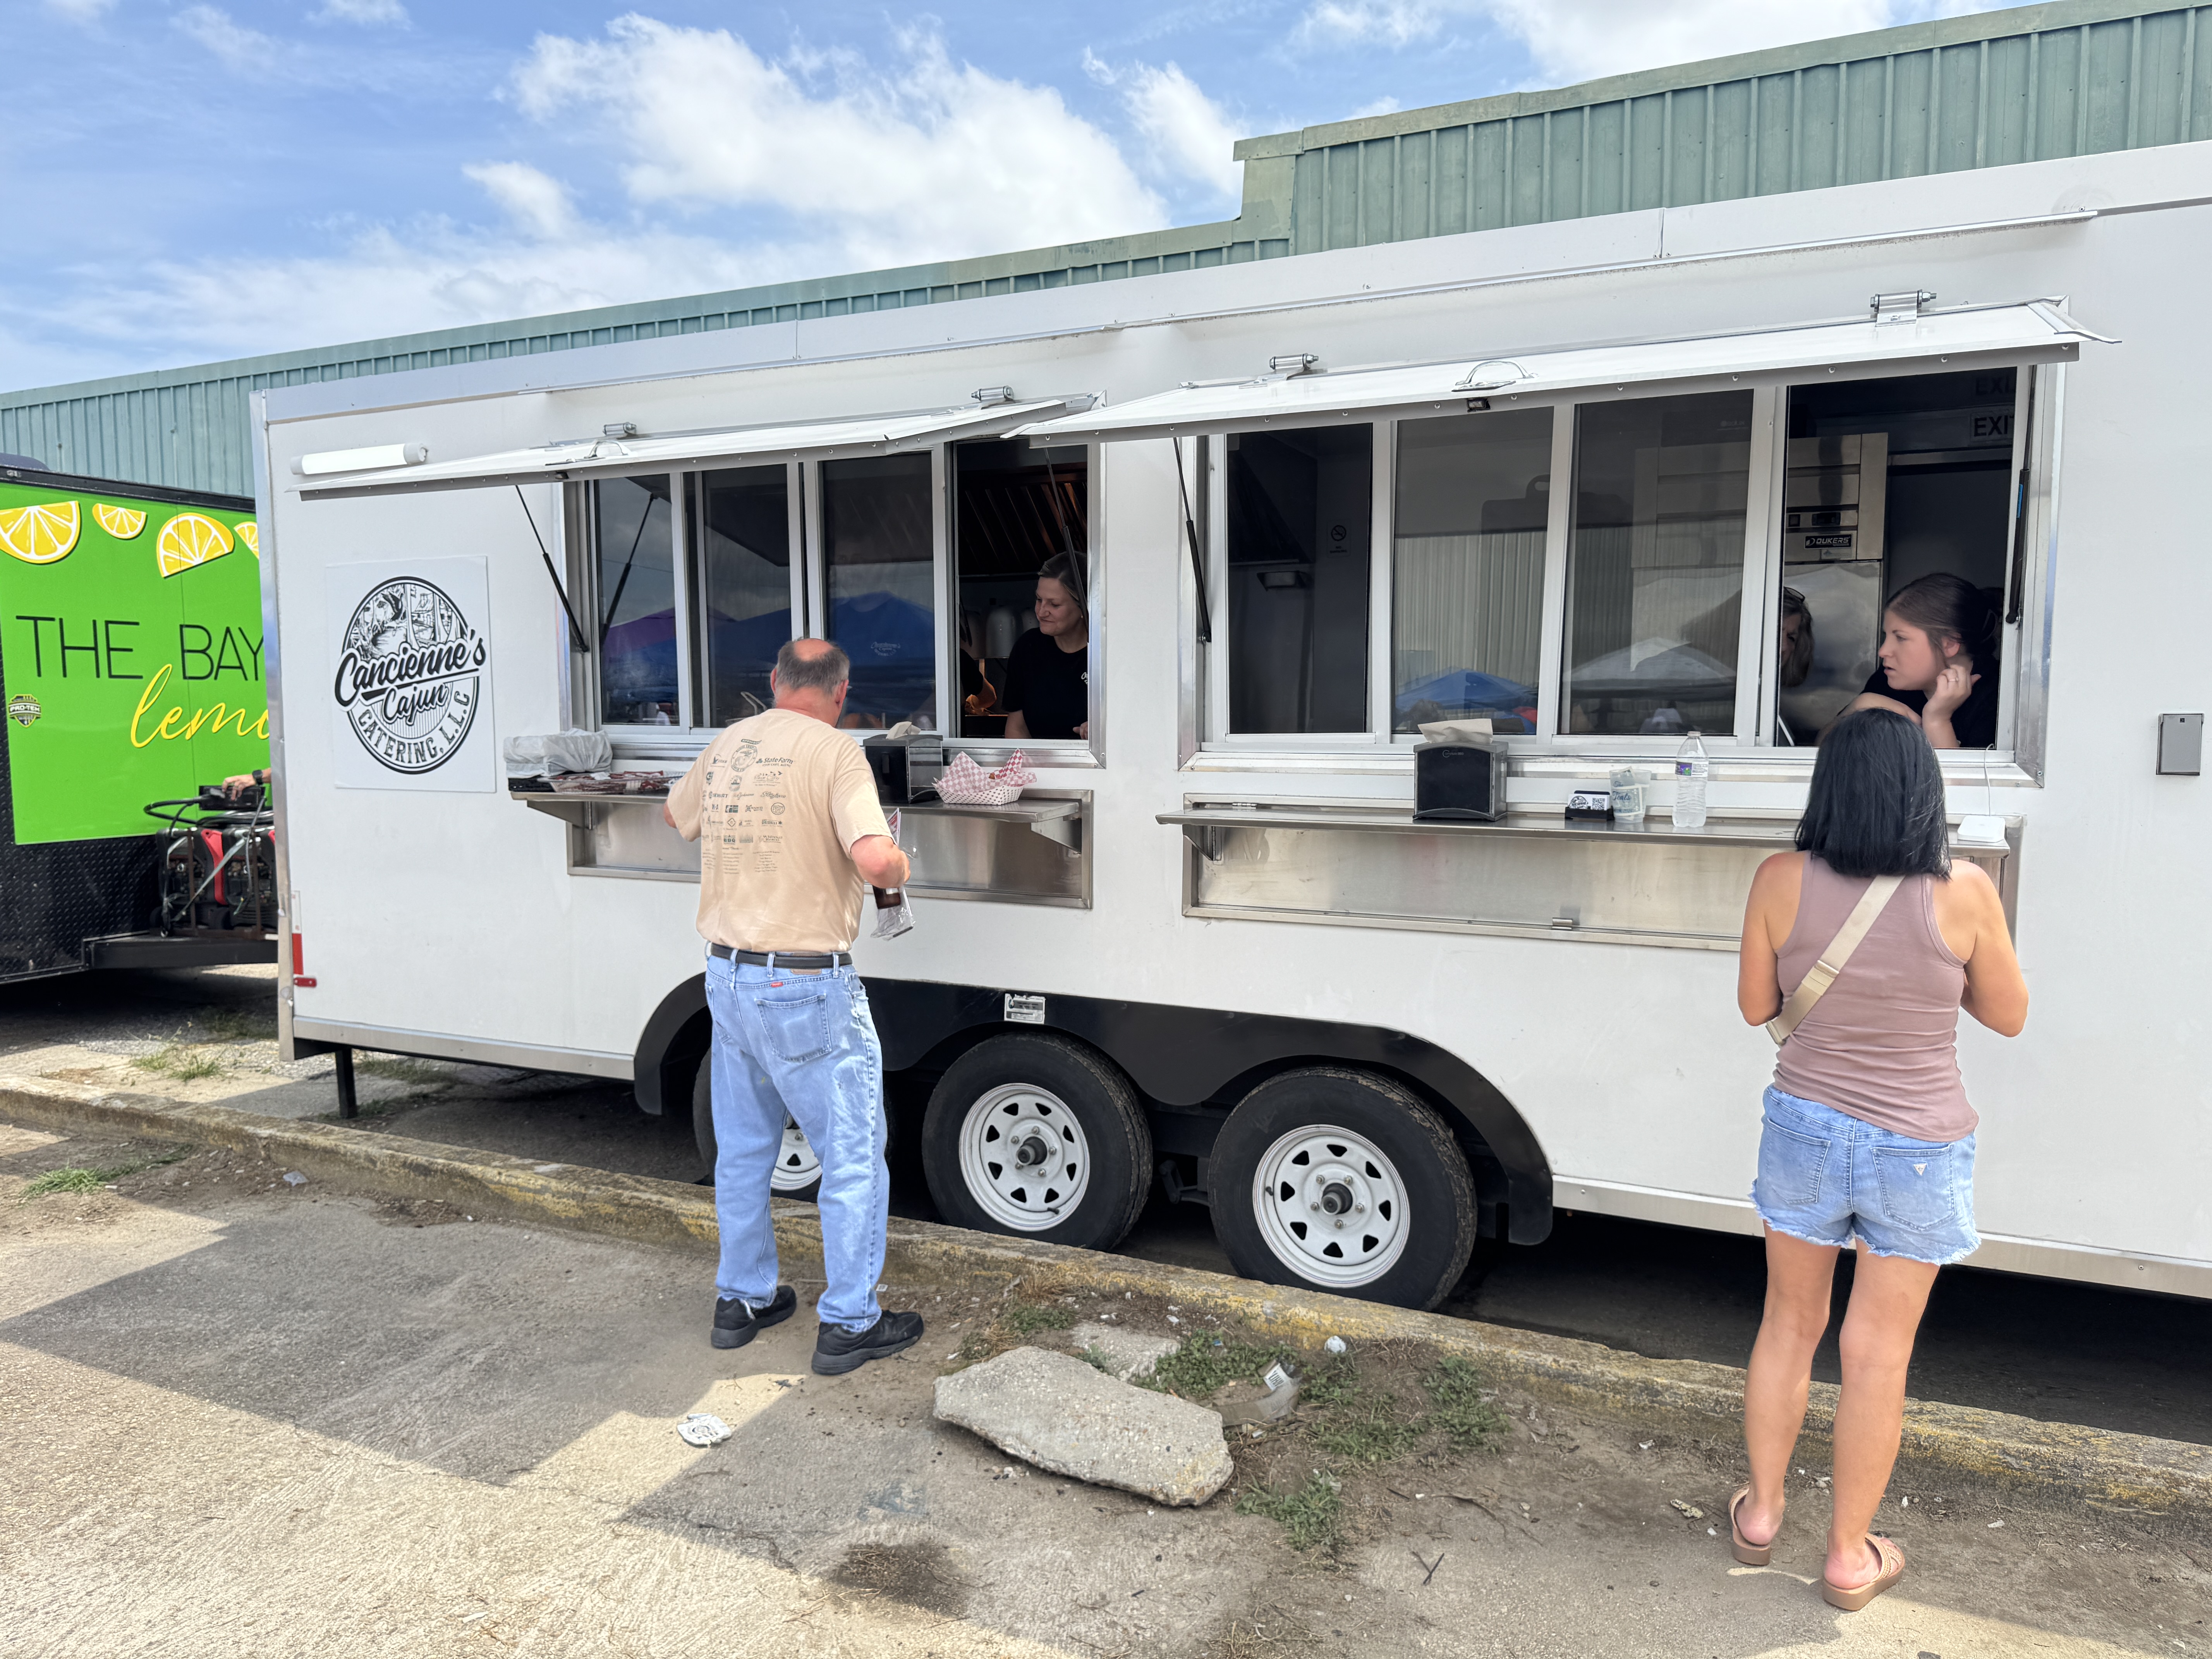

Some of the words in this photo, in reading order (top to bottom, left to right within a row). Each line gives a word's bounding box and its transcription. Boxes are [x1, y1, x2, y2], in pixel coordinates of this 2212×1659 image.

[16, 615, 143, 679] THE
[335, 629, 486, 707] Cancienne's
[383, 684, 448, 724] Cajun
